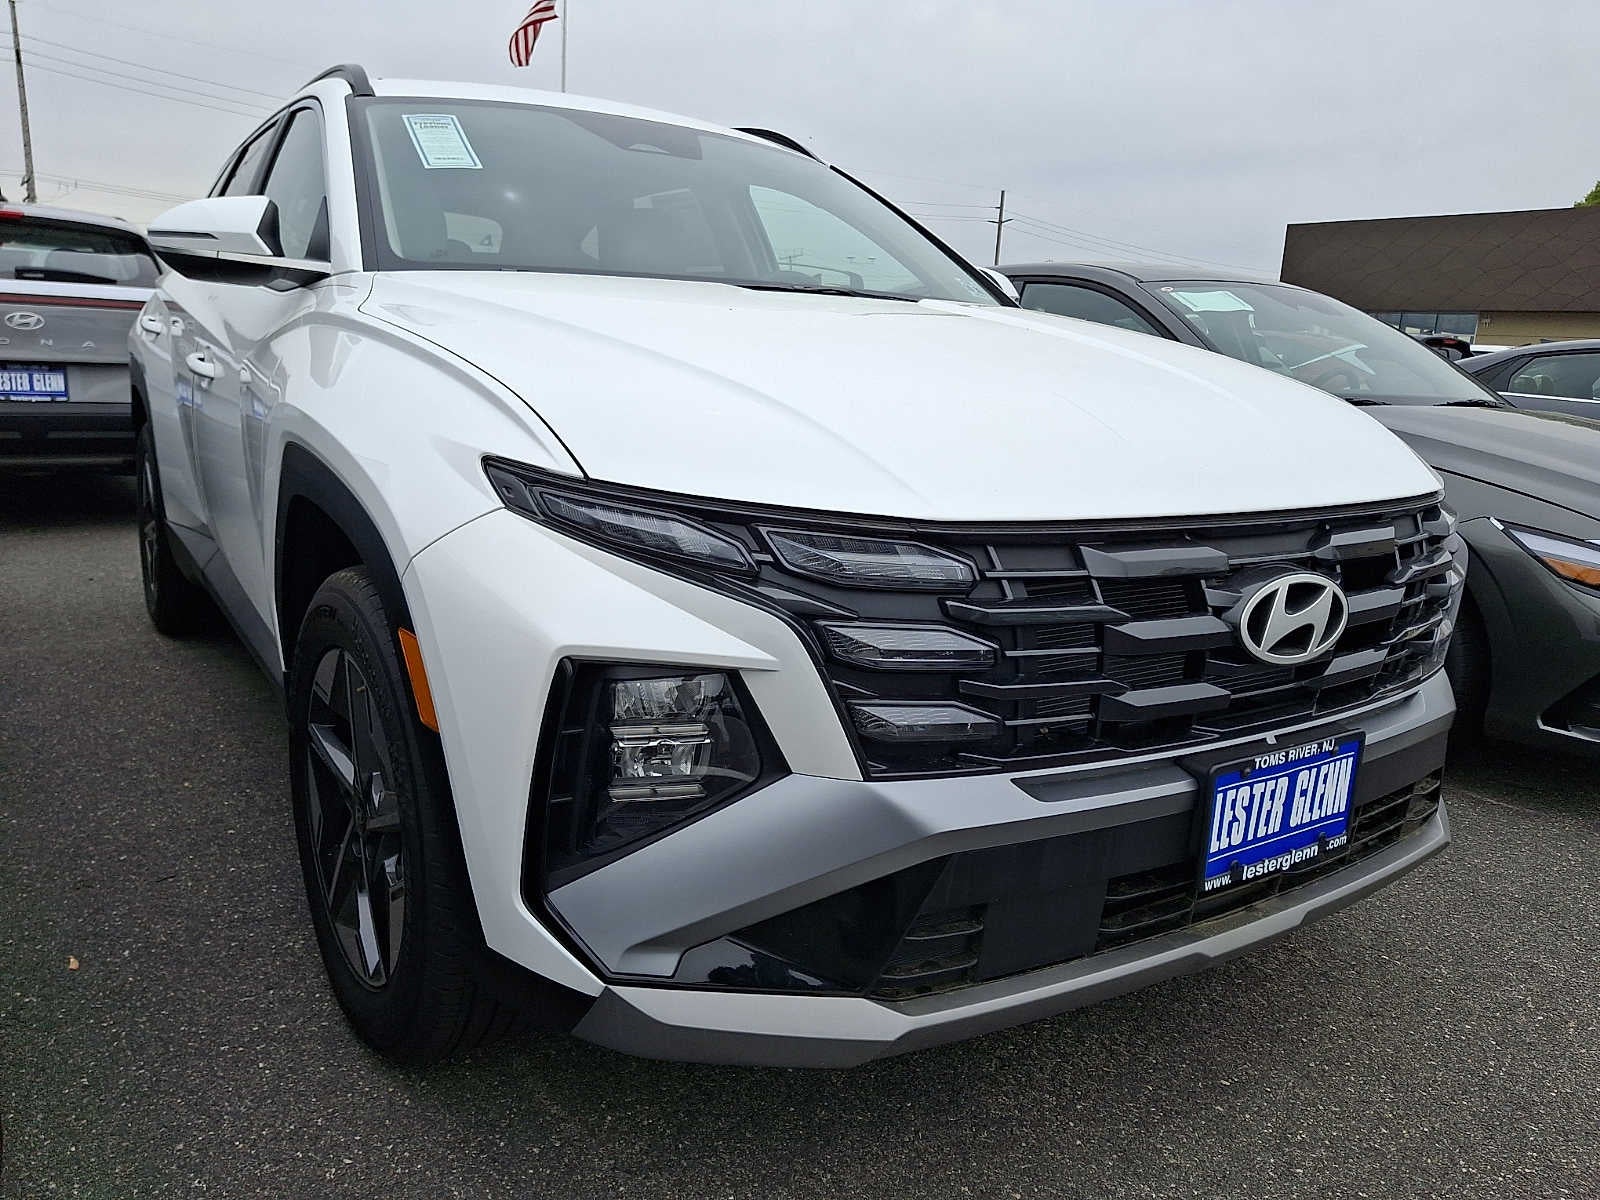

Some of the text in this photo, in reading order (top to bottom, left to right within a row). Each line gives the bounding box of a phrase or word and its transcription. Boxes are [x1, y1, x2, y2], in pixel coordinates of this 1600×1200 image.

[32, 373, 66, 392] GLENN
[1254, 739, 1336, 770] TOMS RIVER, NJ
[1209, 757, 1354, 854] LESTER GLENN
